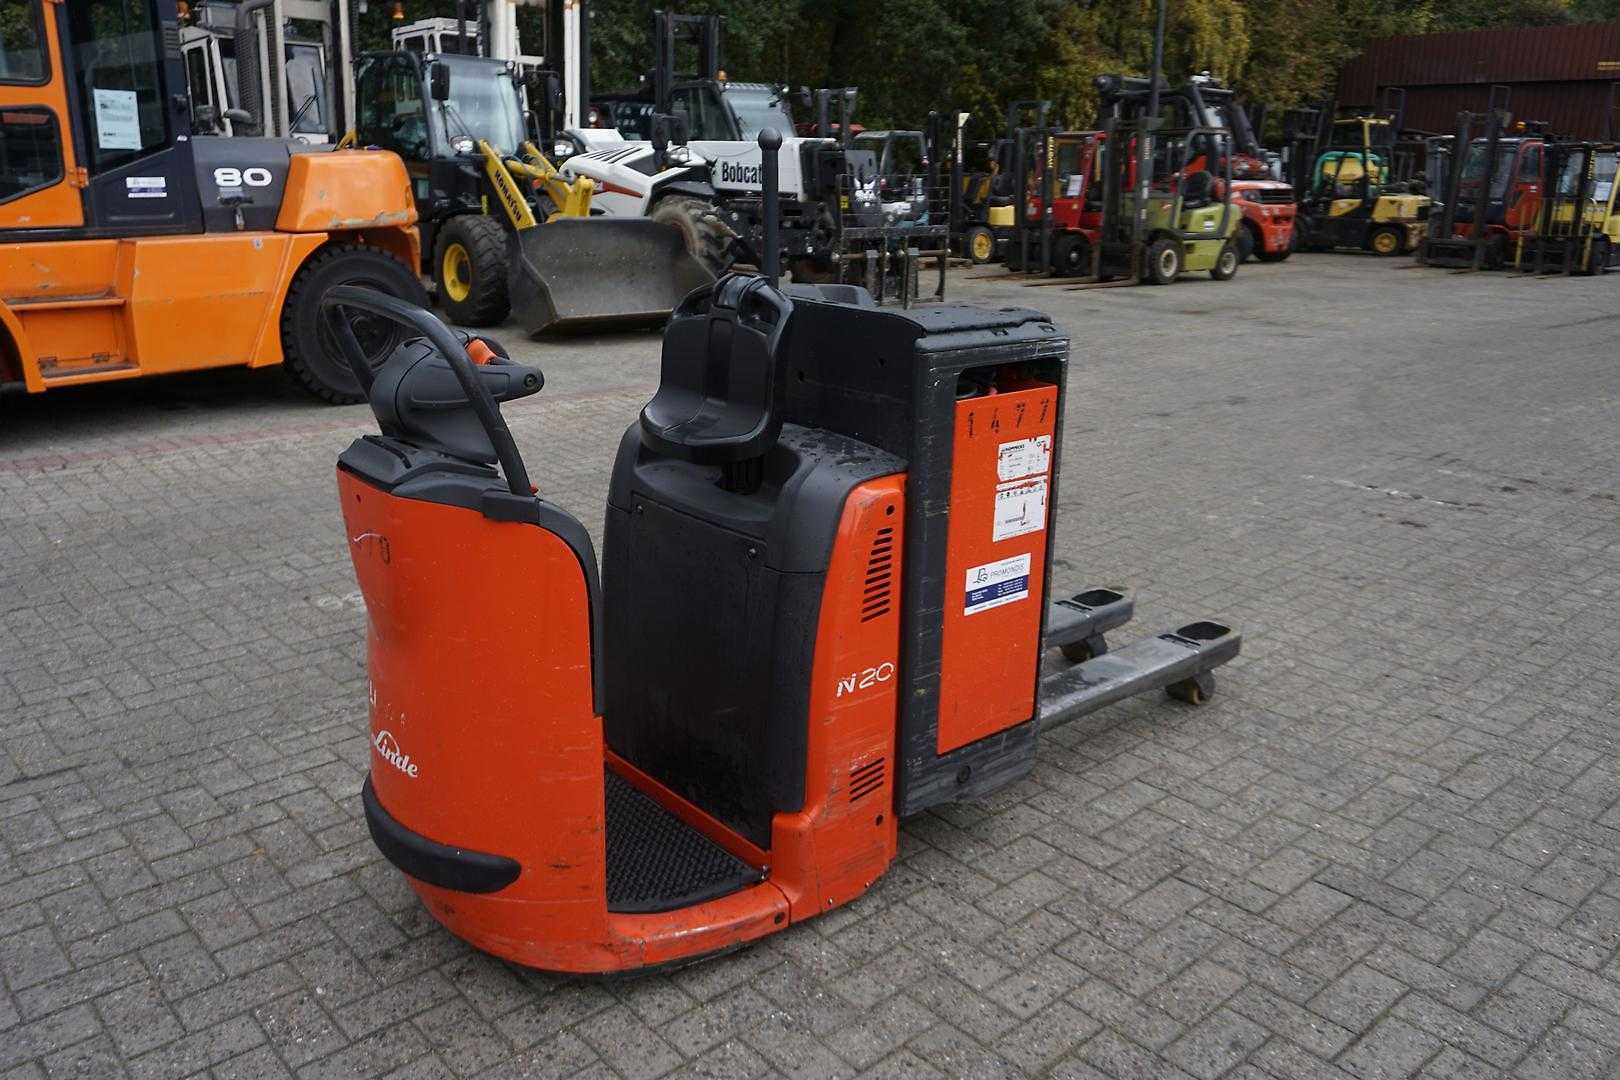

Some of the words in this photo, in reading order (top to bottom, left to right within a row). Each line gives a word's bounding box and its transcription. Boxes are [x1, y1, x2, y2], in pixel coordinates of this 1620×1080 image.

[213, 167, 272, 187] 80
[859, 662, 895, 689] 20
[373, 730, 418, 778] Linde
